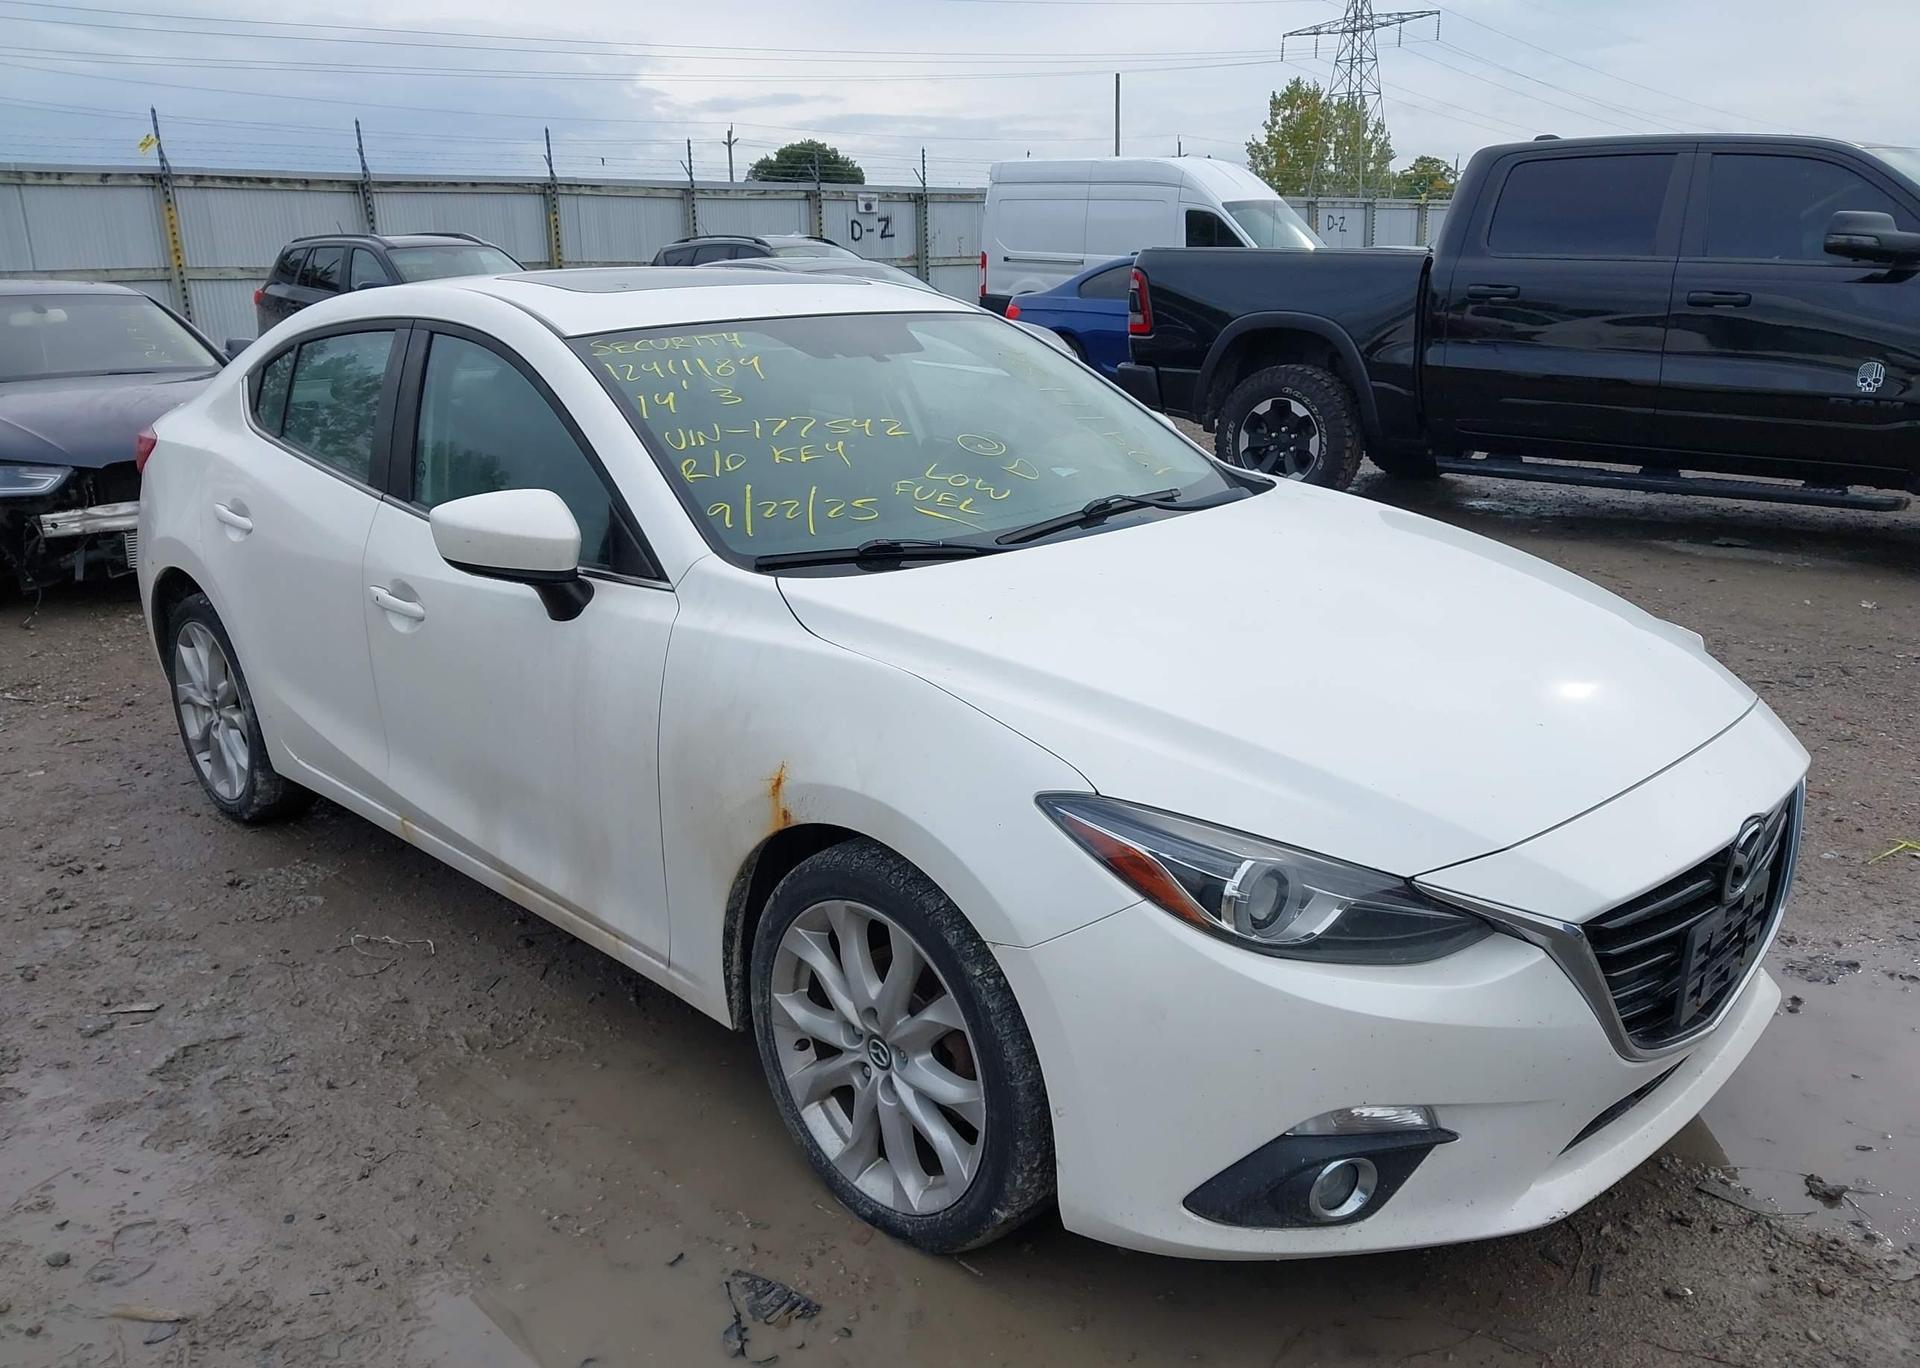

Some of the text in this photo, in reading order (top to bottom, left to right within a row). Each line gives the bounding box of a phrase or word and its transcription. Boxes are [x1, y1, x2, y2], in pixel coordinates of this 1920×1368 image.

[590, 332, 745, 356] SECURITY
[711, 388, 743, 405] 3
[770, 440, 851, 468] KEY
[925, 463, 1011, 500] LOW
[706, 484, 879, 536] 9/22/25
[895, 480, 984, 515] FUEL
